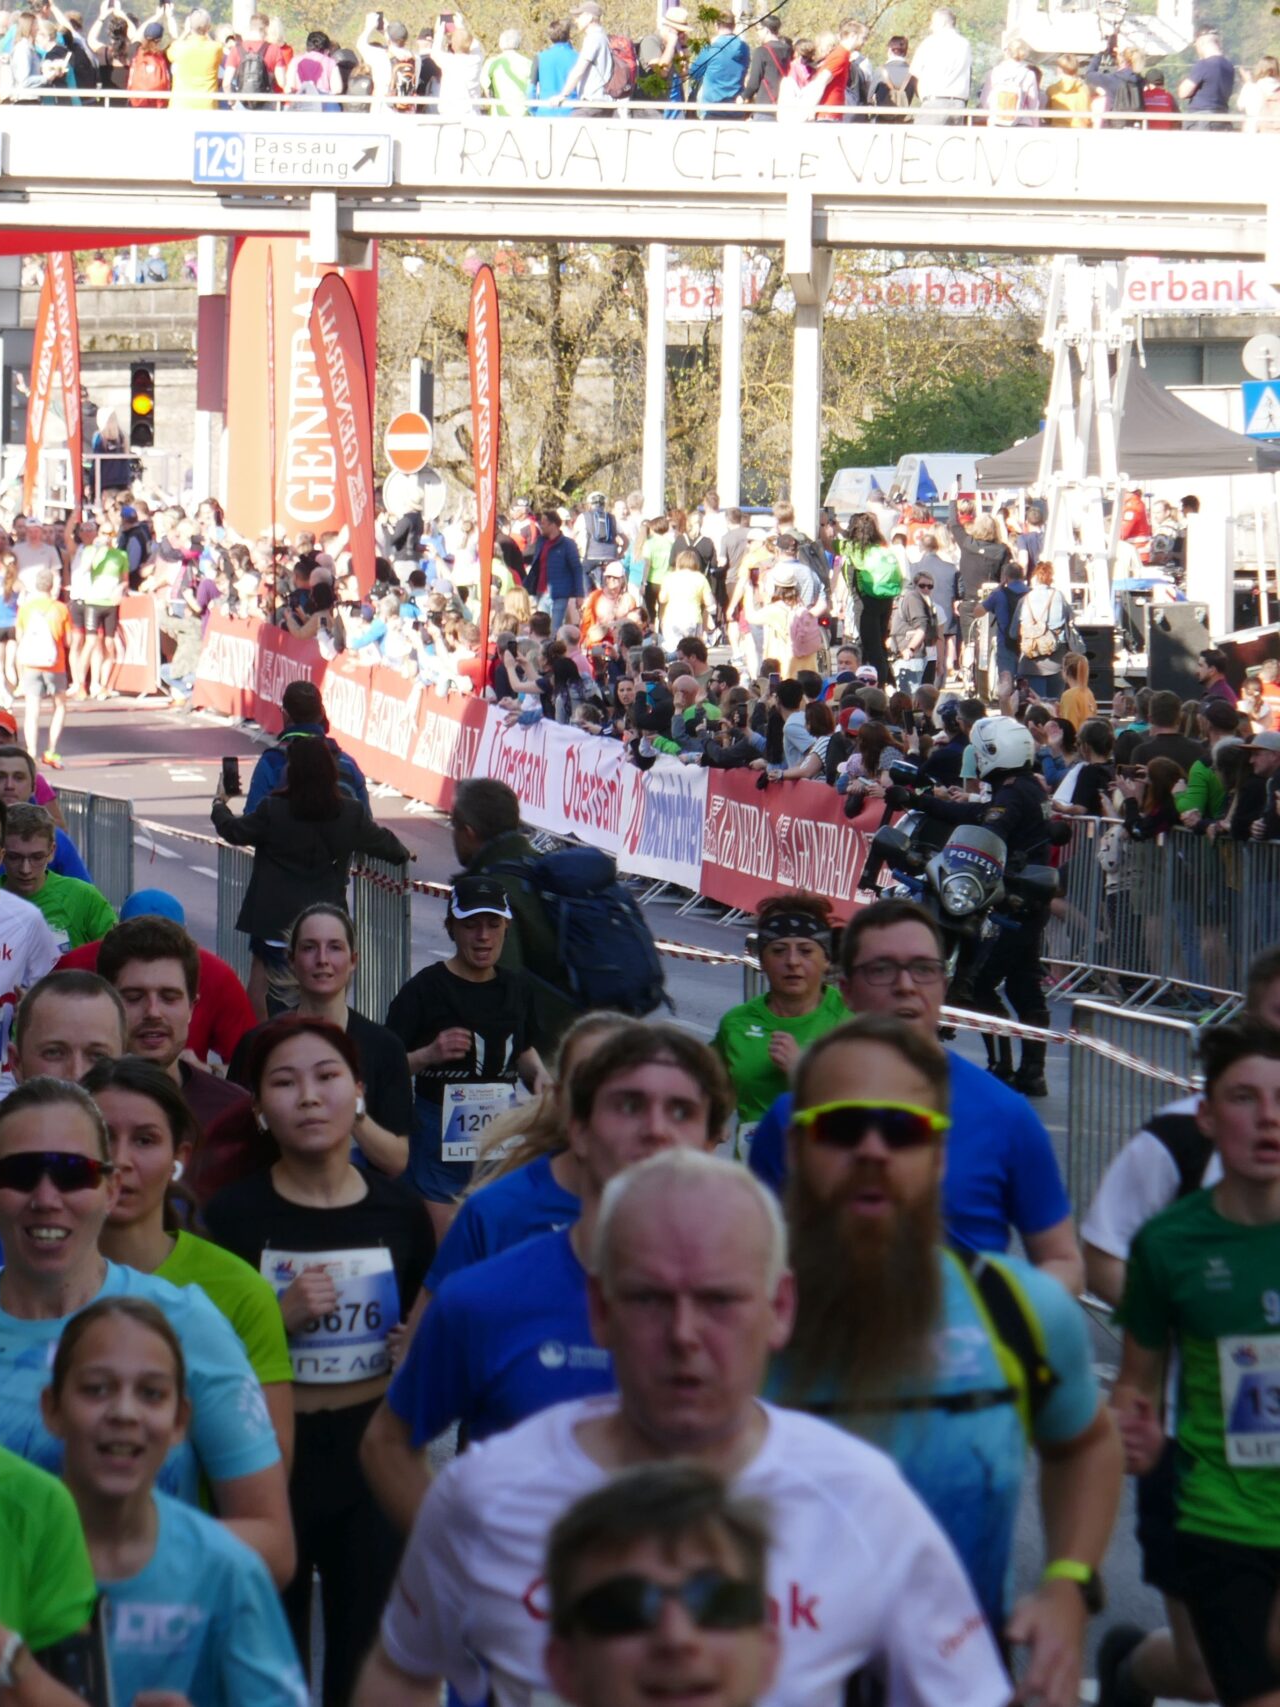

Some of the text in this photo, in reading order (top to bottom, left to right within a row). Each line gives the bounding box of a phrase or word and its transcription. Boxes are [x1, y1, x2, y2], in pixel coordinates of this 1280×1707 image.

[195, 136, 245, 178] 129
[254, 136, 337, 155] Passau
[417, 122, 652, 183] TRAJAT
[254, 156, 349, 179] Eferding
[792, 817, 859, 901] GENERALI
[948, 848, 998, 874] POLIZEI
[456, 1112, 502, 1133] 120
